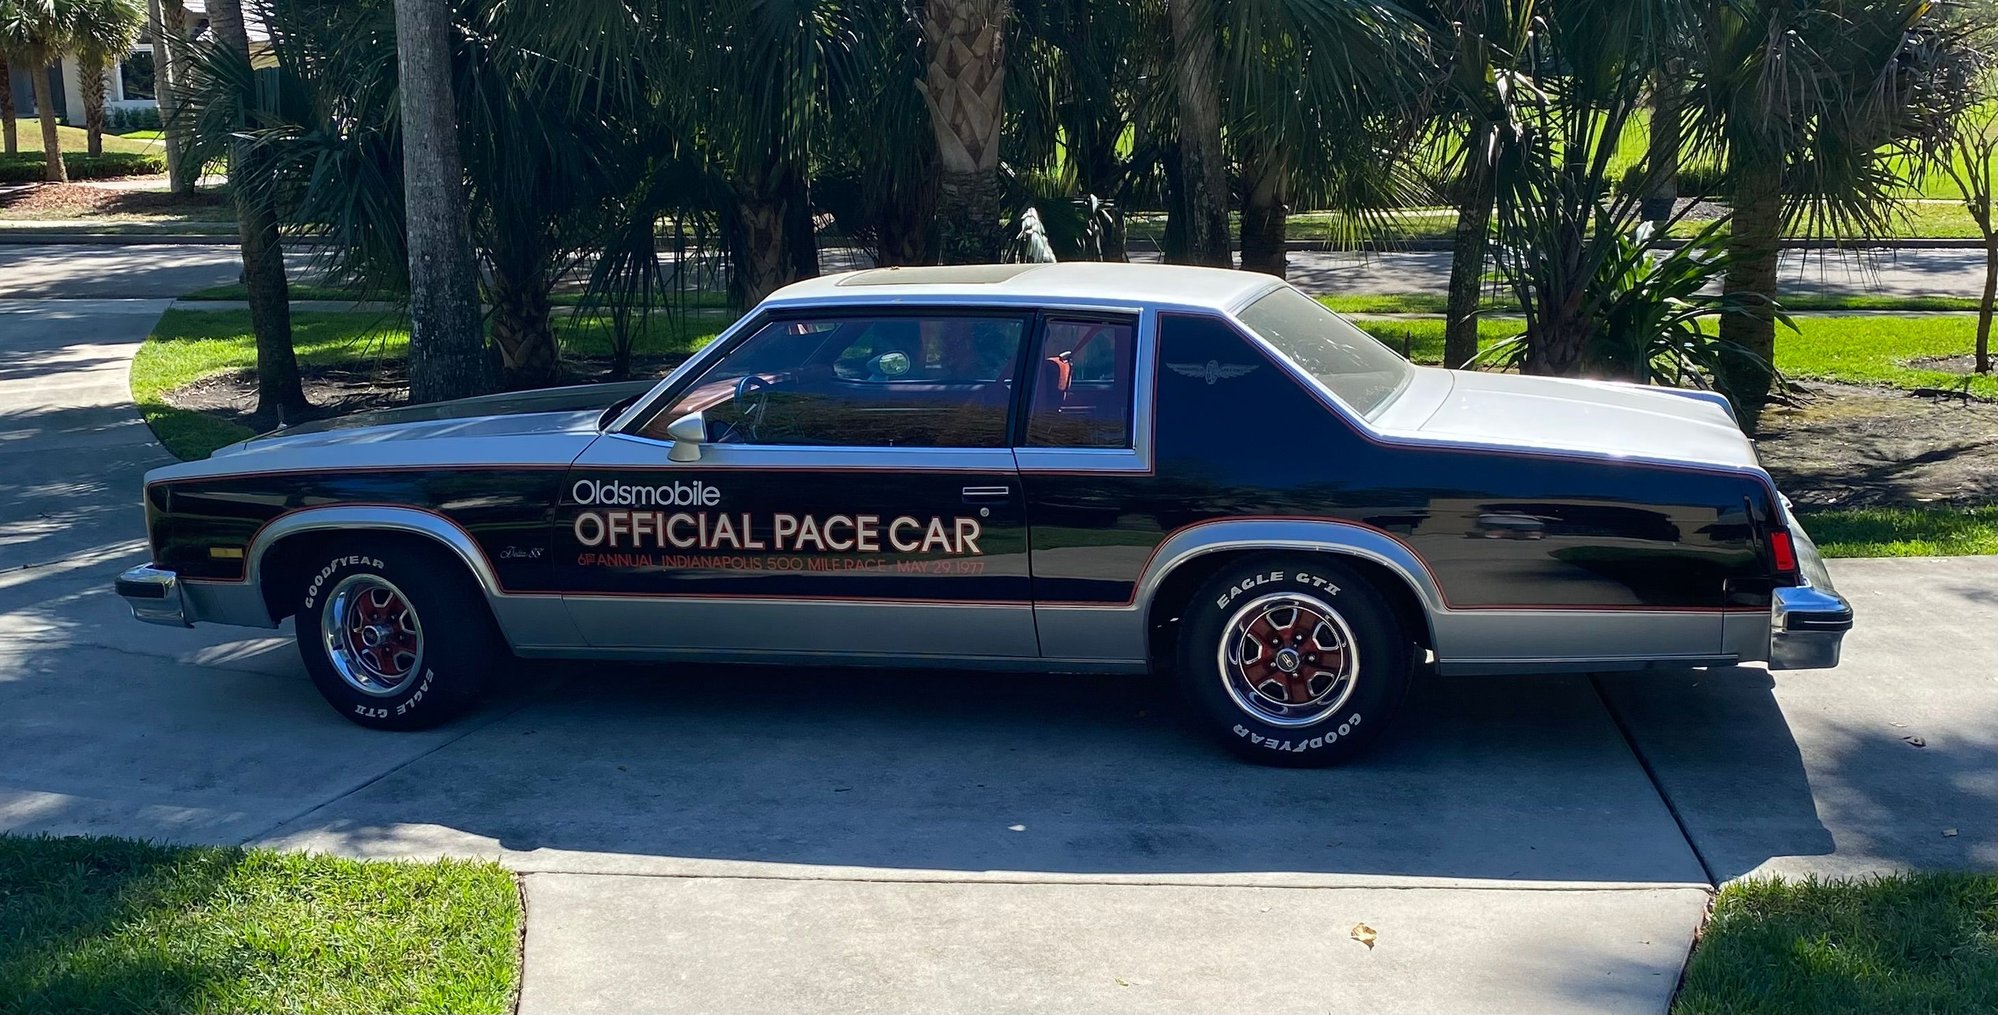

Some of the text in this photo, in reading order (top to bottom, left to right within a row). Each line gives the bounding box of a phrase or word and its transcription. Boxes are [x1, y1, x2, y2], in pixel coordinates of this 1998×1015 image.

[572, 479, 721, 507] Oldsmobile
[574, 511, 983, 555] OFFICIAL PACE CAR
[305, 555, 385, 609] GOODYEAR
[597, 553, 655, 569] ANNUAL
[661, 555, 762, 571] INDIANAPOLIS
[767, 556, 804, 571] 500
[807, 557, 841, 572] MILE
[844, 558, 887, 573] RACE
[895, 560, 928, 574] MAY
[1216, 571, 1284, 610] EAGLE
[396, 668, 434, 716] EAGLE
[1232, 712, 1362, 752] GOODYEAR
